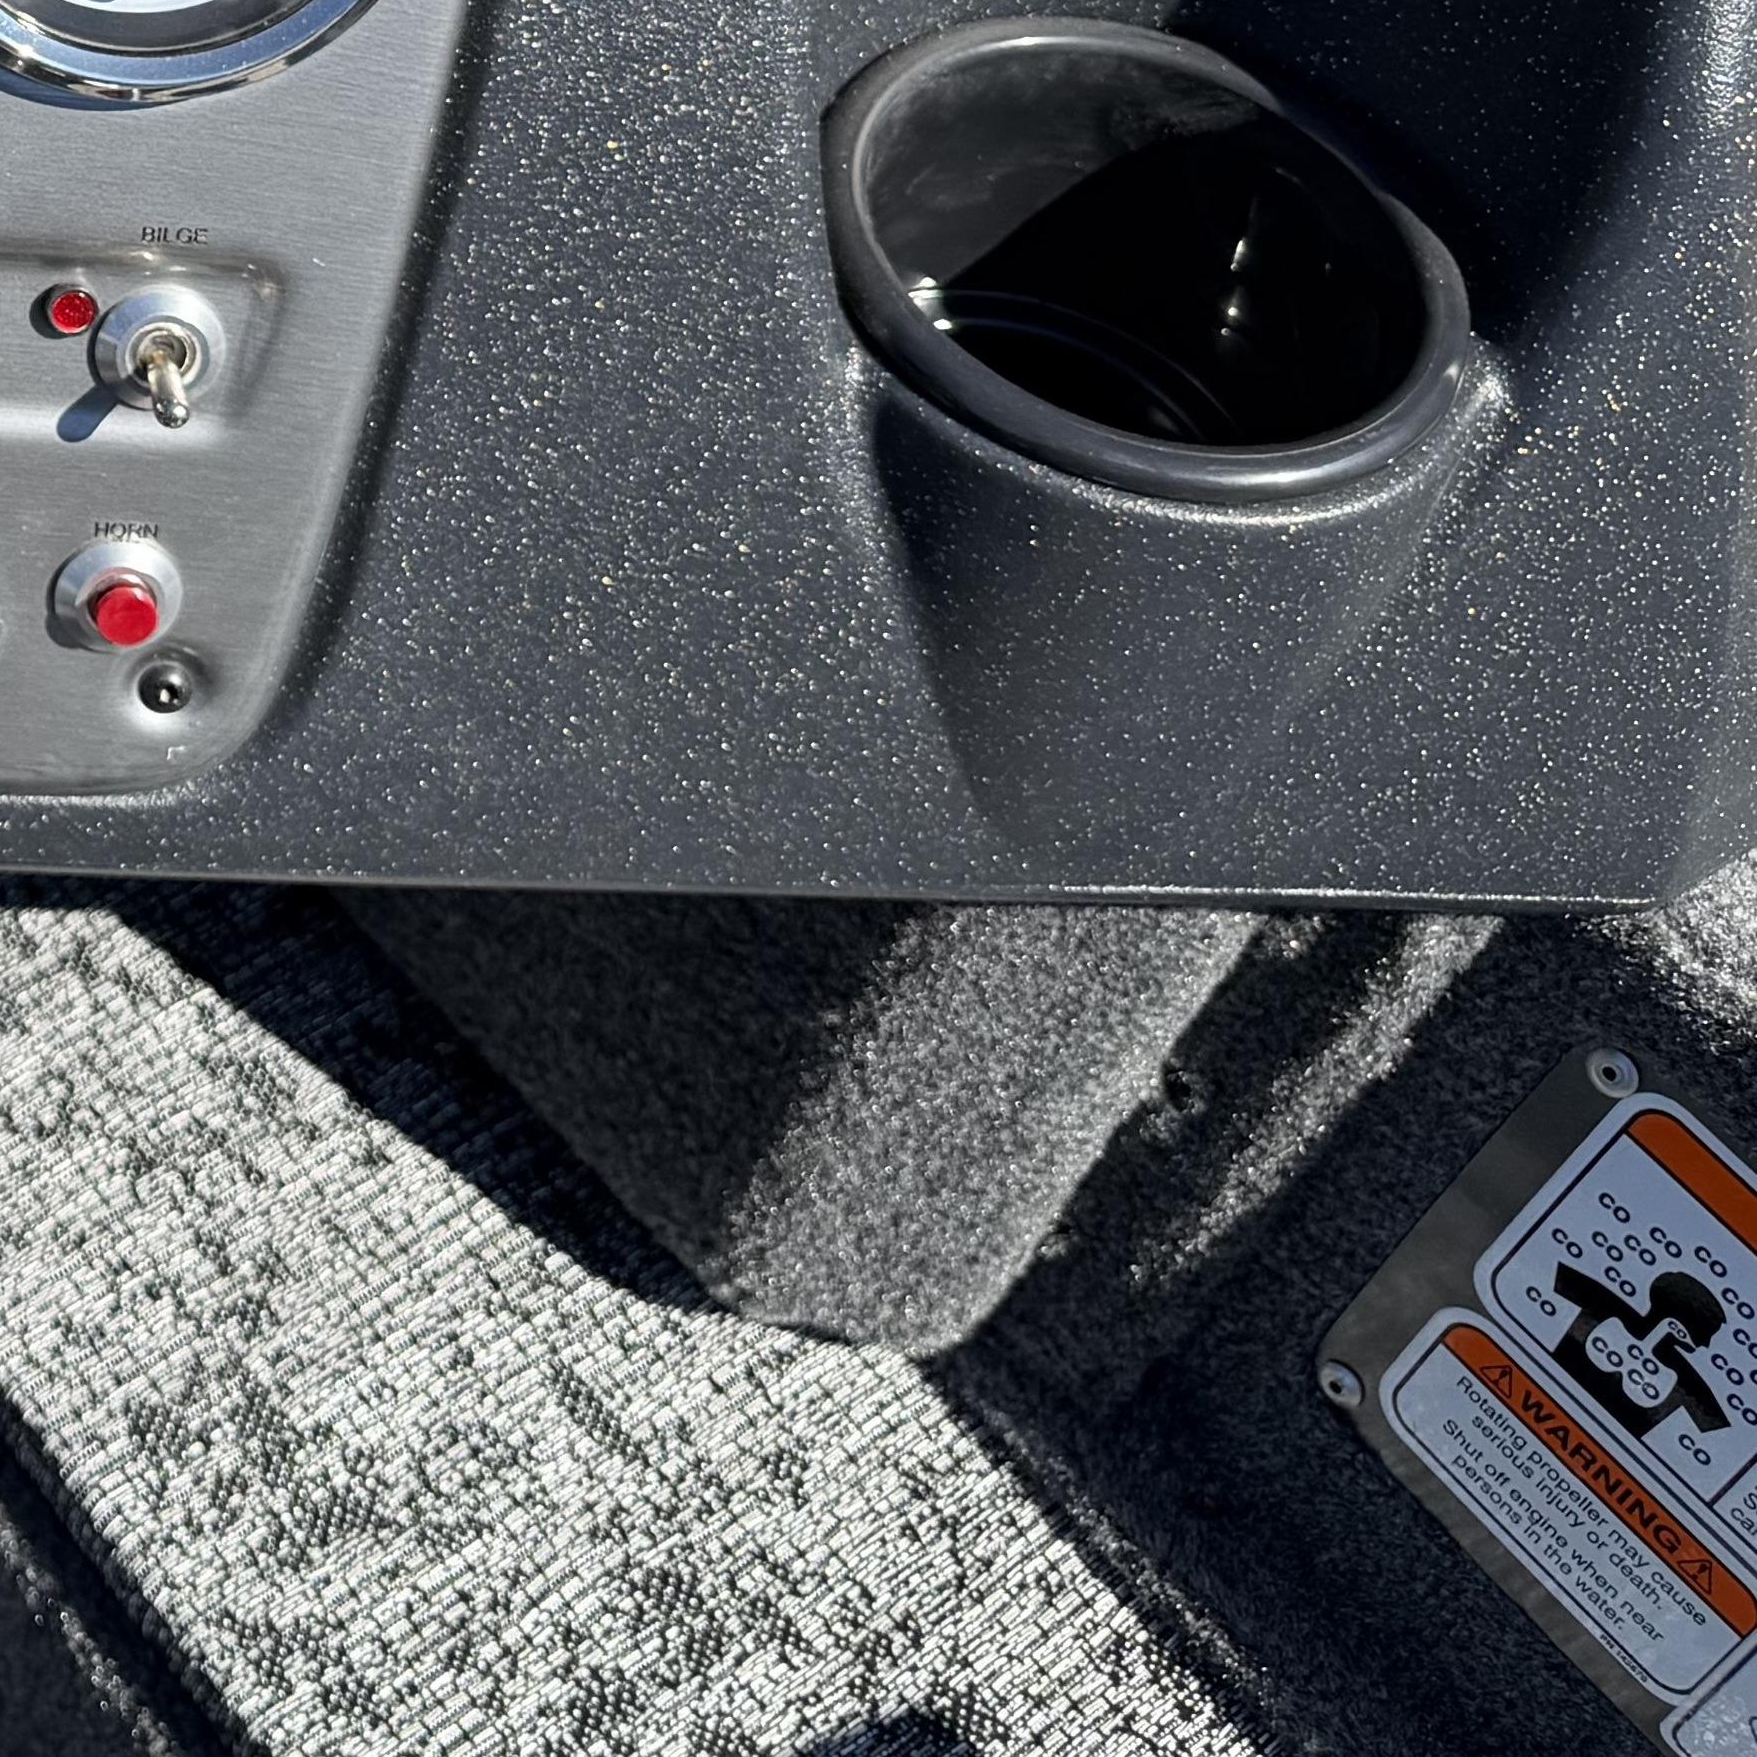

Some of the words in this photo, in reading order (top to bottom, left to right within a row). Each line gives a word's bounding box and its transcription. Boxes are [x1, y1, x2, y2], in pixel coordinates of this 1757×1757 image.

[142, 227, 208, 244] BILGE
[93, 522, 158, 539] HORN
[1598, 1193, 1630, 1223] CO
[1551, 1228, 1583, 1258] CO
[1591, 1231, 1623, 1261] CO
[1624, 1234, 1656, 1265] CO
[1650, 1227, 1682, 1258] CO
[1694, 1246, 1727, 1277] CO
[1604, 1266, 1636, 1297] CO
[1526, 1286, 1556, 1316] CO
[1721, 1288, 1755, 1319] CO
[1667, 1320, 1687, 1339] CO
[1591, 1337, 1623, 1367] CO
[1627, 1344, 1659, 1375] CO
[1627, 1369, 1659, 1400] CO
[1711, 1354, 1744, 1385] CO
[1678, 1434, 1711, 1465] CO
[1522, 1390, 1680, 1553] WARNING
[1456, 1375, 1527, 1451] Rotating
[1526, 1450, 1608, 1526] propeller
[1607, 1529, 1650, 1568] may
[1650, 1571, 1706, 1625] cause
[1471, 1415, 1534, 1478] serious
[1535, 1477, 1585, 1527] injury
[1586, 1530, 1608, 1549] or
[1608, 1552, 1661, 1609] death.
[1442, 1418, 1483, 1462] Shut
[1484, 1463, 1510, 1486] off
[1509, 1488, 1567, 1548] engine
[1571, 1548, 1618, 1598] when
[1619, 1600, 1663, 1640] near
[1451, 1454, 1522, 1524] persons
[1523, 1521, 1541, 1544] in
[1542, 1543, 1572, 1575] the
[1575, 1576, 1624, 1629] water.
[1599, 1633, 1614, 1649] PN
